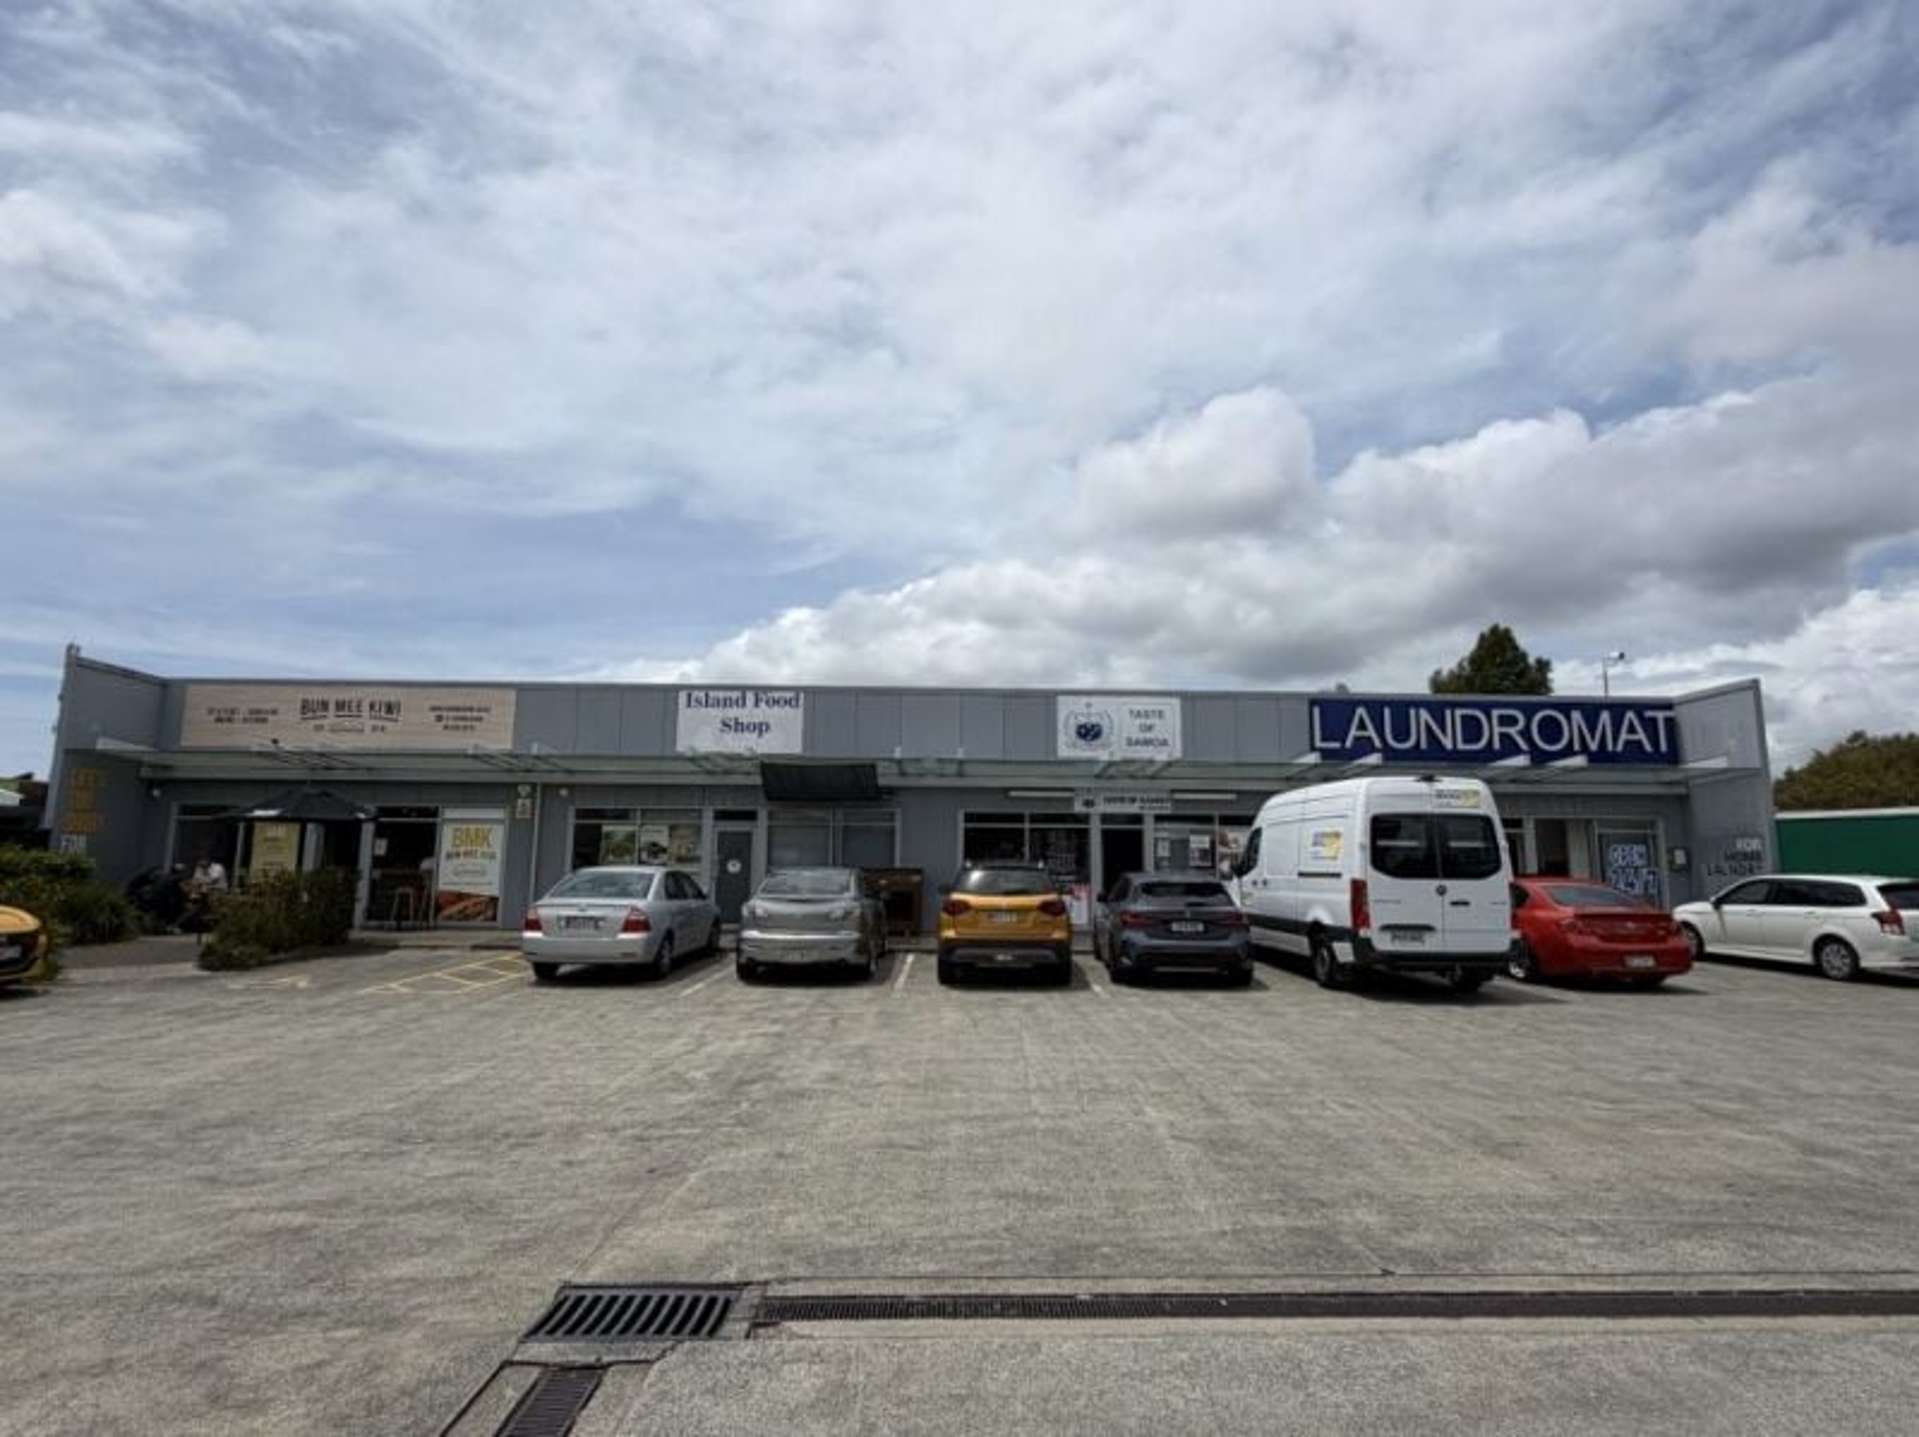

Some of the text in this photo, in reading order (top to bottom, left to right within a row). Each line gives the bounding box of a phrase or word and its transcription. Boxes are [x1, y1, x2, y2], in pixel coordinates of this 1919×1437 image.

[300, 699, 402, 717] BUN MEE KIWI
[686, 691, 800, 708] Island Food
[1128, 709, 1164, 720] TASTE
[719, 717, 771, 738] Shop
[1138, 723, 1154, 733] OF
[1312, 704, 1675, 753] LAUNDROMAT
[450, 826, 493, 849] BMK
